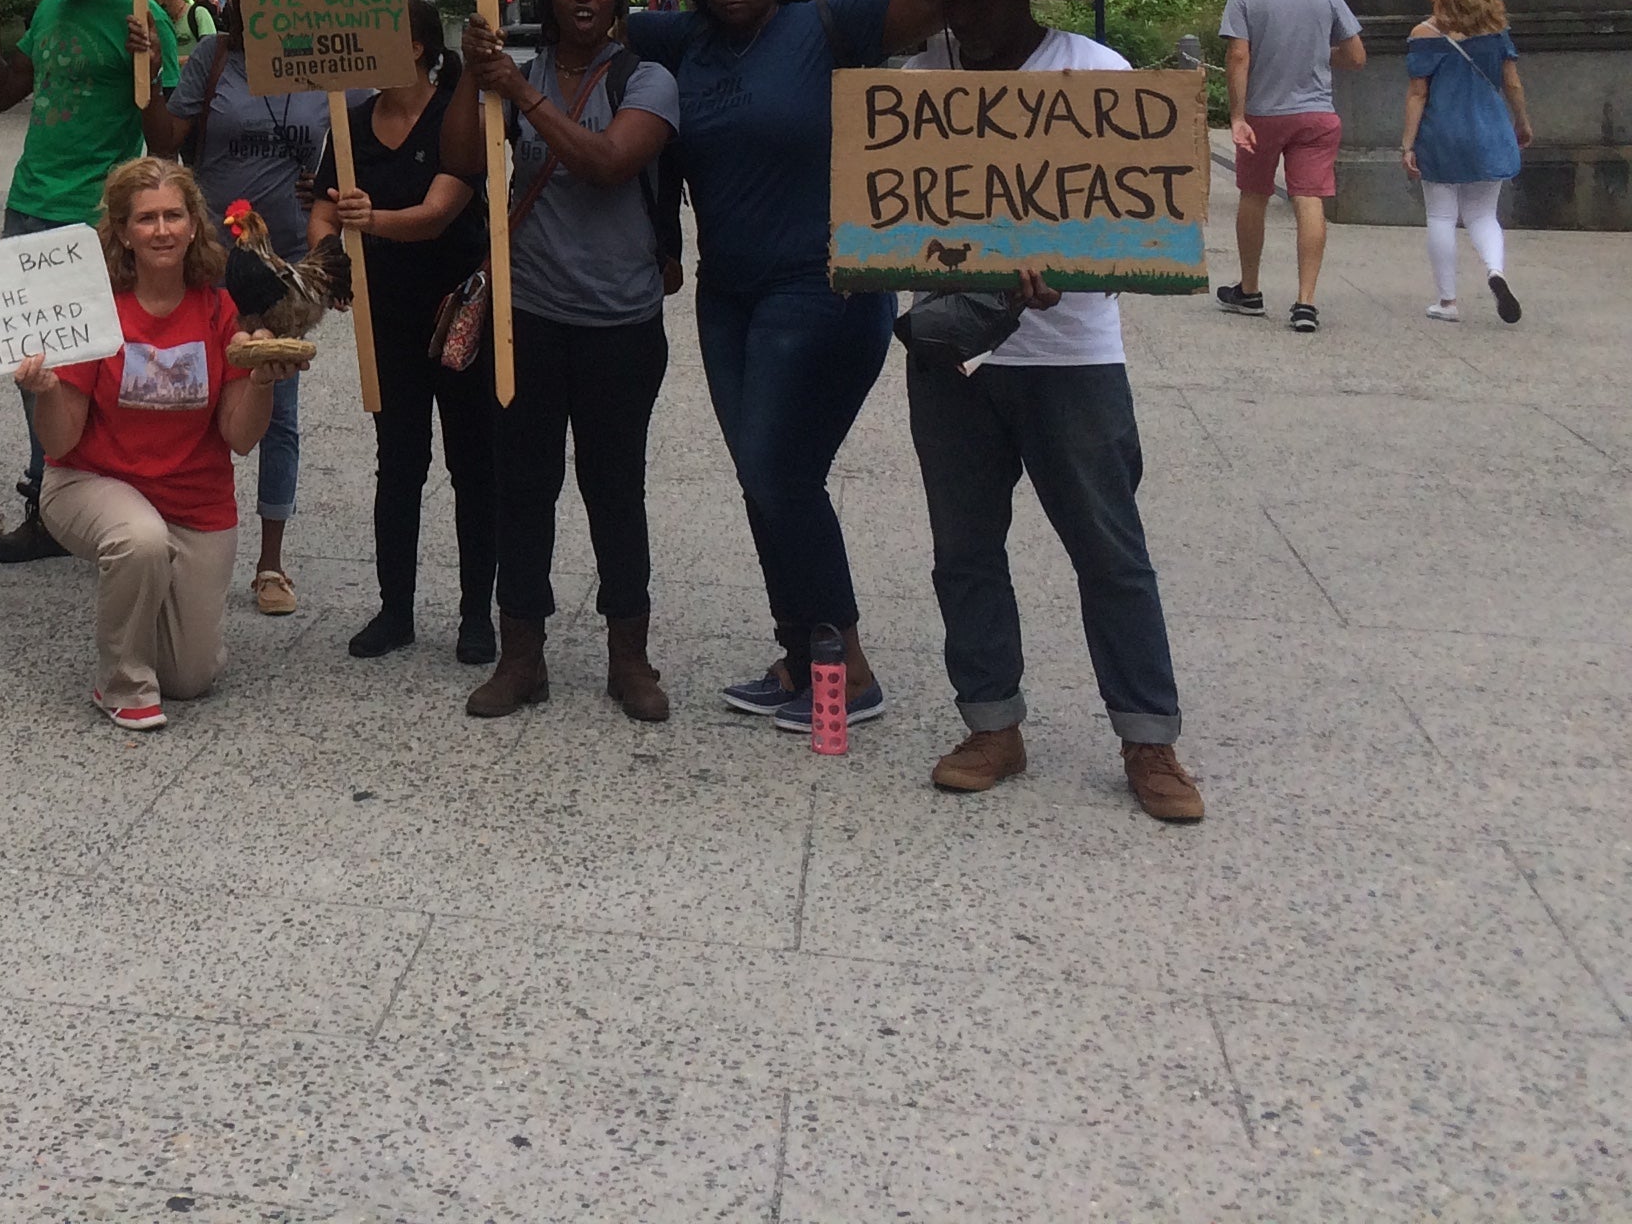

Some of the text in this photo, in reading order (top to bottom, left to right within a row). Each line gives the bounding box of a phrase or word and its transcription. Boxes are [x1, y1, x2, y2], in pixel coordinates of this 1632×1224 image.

[249, 7, 404, 40] COMMUNITY
[317, 32, 363, 55] SOIL
[272, 56, 377, 78] generation
[864, 84, 1178, 151] BACKYARD
[274, 125, 312, 145] OIL
[866, 160, 1194, 229] BREAKFAST
[18, 243, 83, 274] BACK
